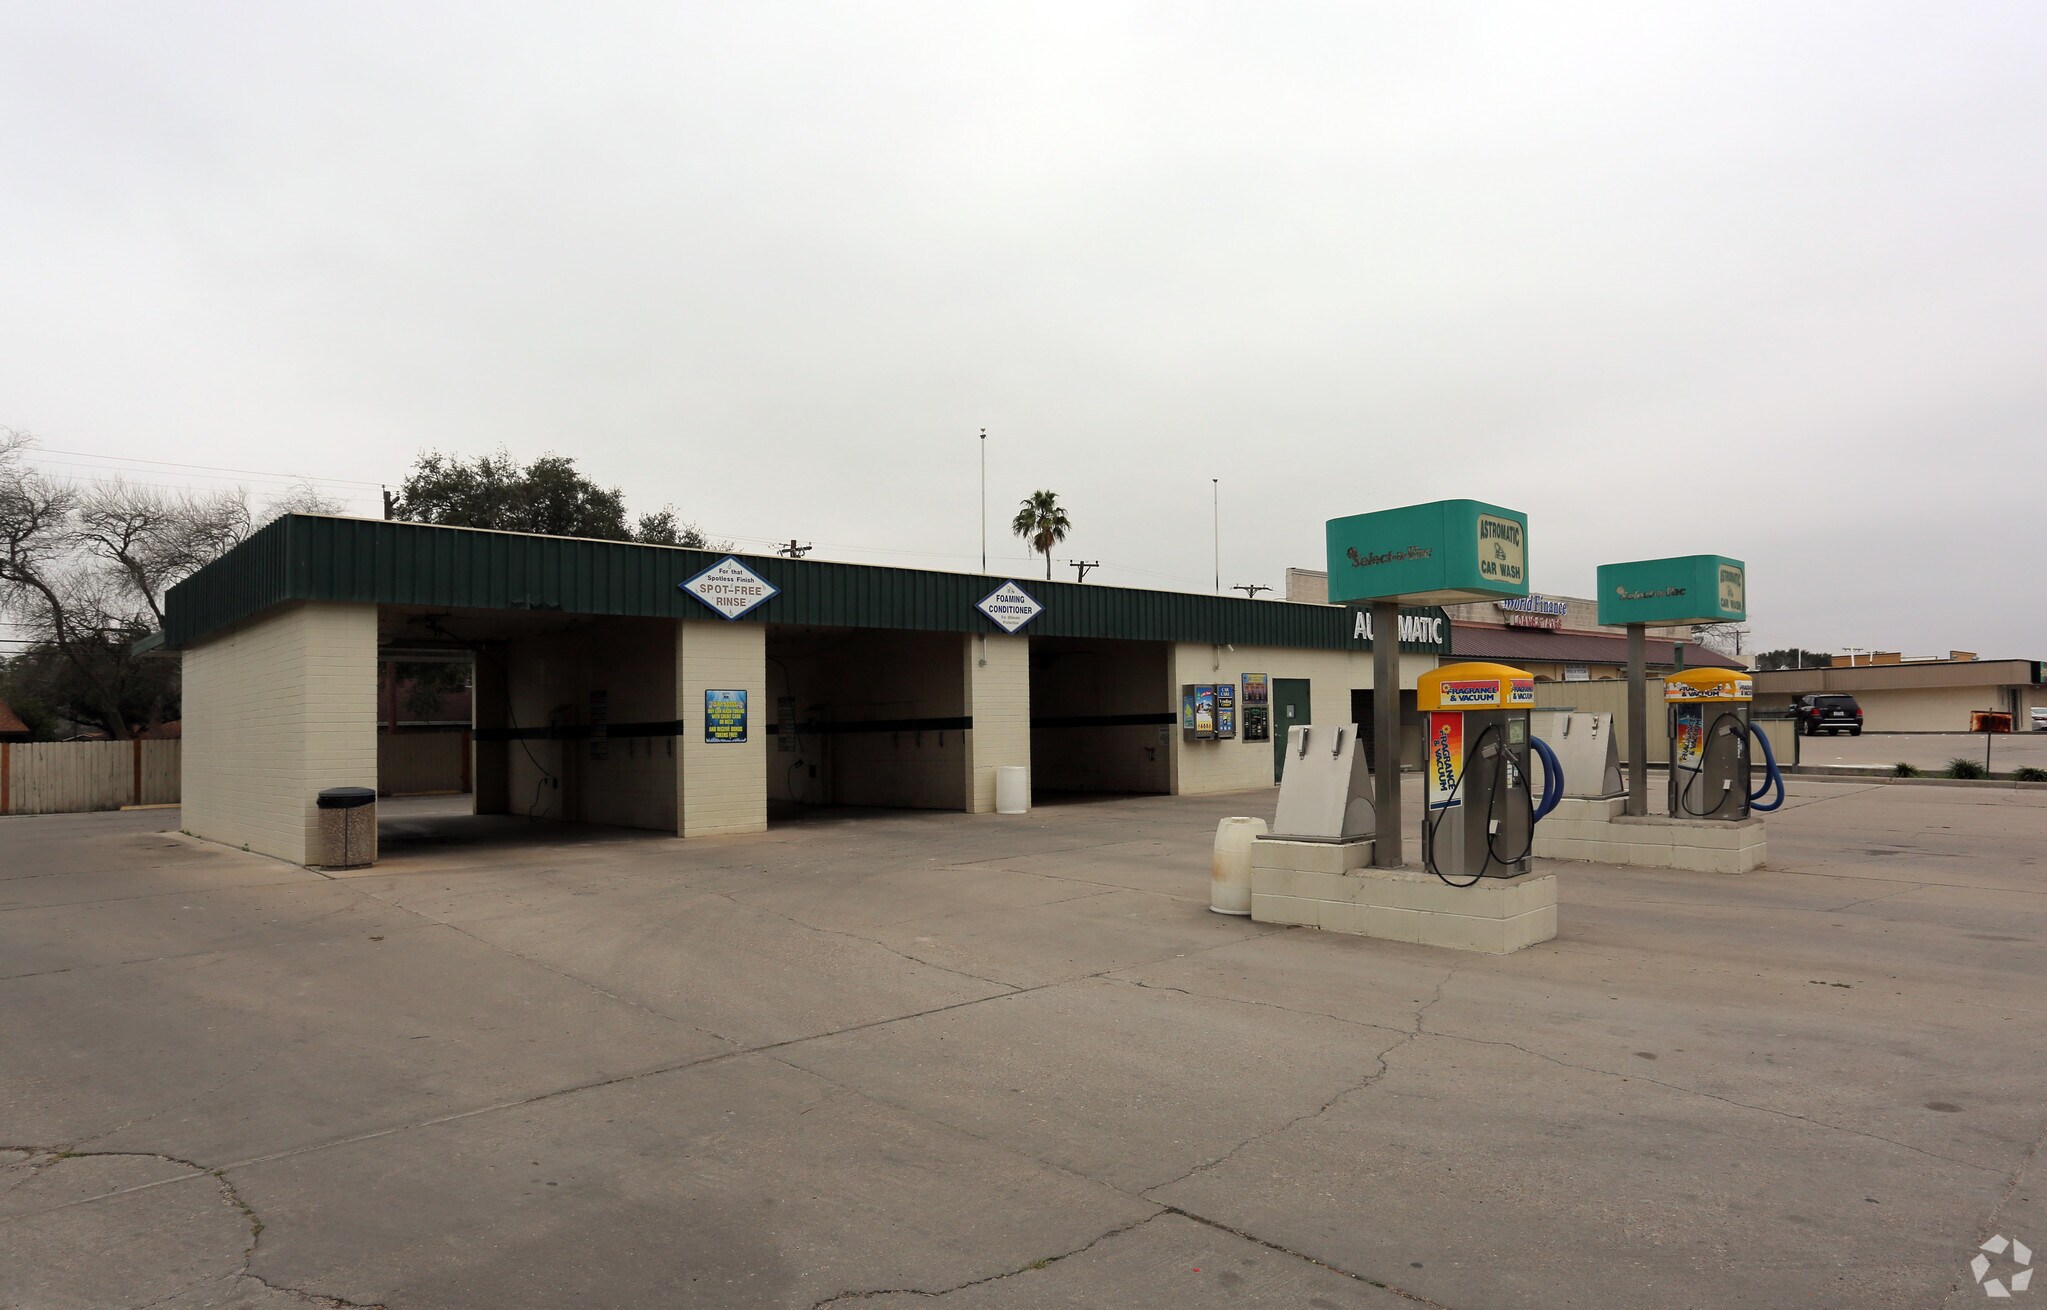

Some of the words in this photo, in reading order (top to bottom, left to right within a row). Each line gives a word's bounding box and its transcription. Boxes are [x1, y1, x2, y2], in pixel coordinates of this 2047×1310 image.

[1480, 520, 1520, 547] ASTROMATIC
[1481, 560, 1497, 575] CAR
[1500, 563, 1521, 579] WASH
[700, 584, 762, 595] SPOT-FREE
[996, 595, 1025, 603] FOAMING
[716, 597, 746, 607] RINSE
[988, 605, 1032, 614] CONDITIONER
[1504, 595, 1533, 611] World
[1534, 596, 1567, 615] Finance
[1354, 612, 1442, 644] AUMATIC
[1439, 729, 1456, 790] FRAGRANCE
[1435, 748, 1448, 791] VACUUM
